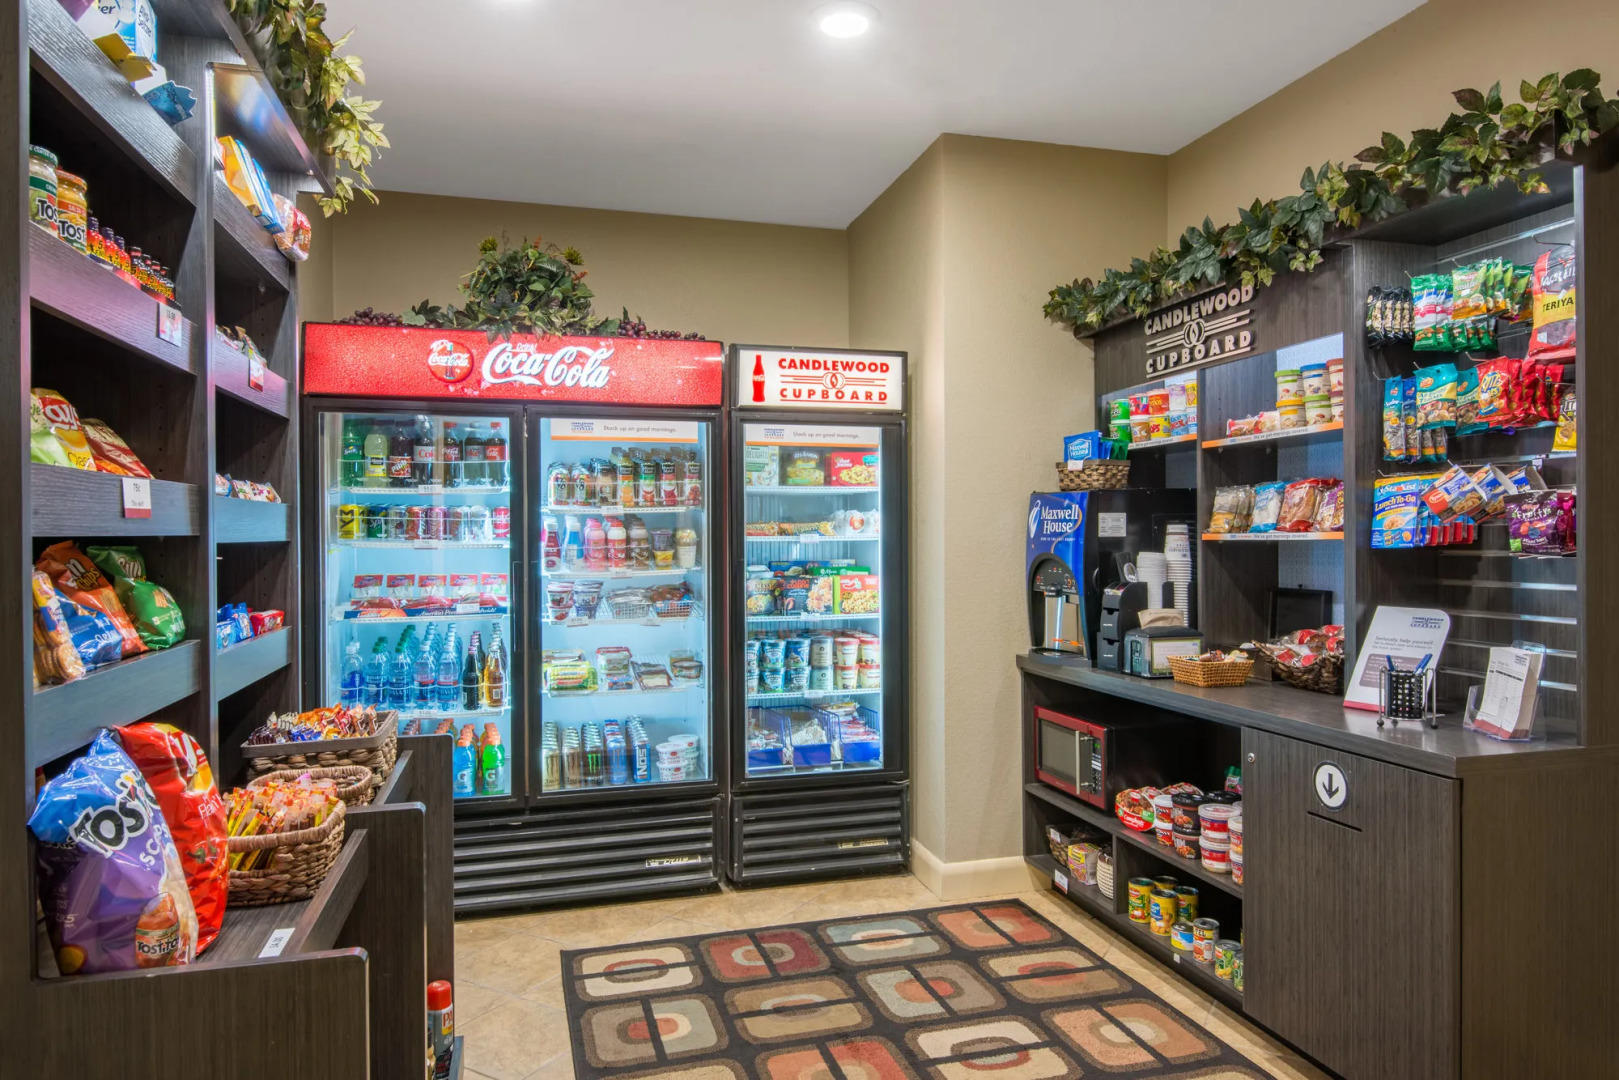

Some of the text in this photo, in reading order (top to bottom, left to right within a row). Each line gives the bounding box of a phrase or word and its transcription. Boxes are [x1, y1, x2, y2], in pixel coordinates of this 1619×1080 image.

[1144, 285, 1254, 336] CANDLEWOOD
[427, 352, 470, 367] Coca-Cola
[1145, 330, 1252, 374] CUPBOARD
[482, 343, 615, 388] Coca-Cola
[778, 358, 890, 373] CANDLEWOOD
[779, 388, 888, 401] CUPBOARD
[1375, 494, 1416, 512] Lunch To-Go
[1040, 504, 1079, 520] Maxwell
[1043, 520, 1073, 534] House
[76, 566, 100, 589] Chips
[636, 744, 649, 776] NOS
[137, 937, 180, 954] TOSTITO
